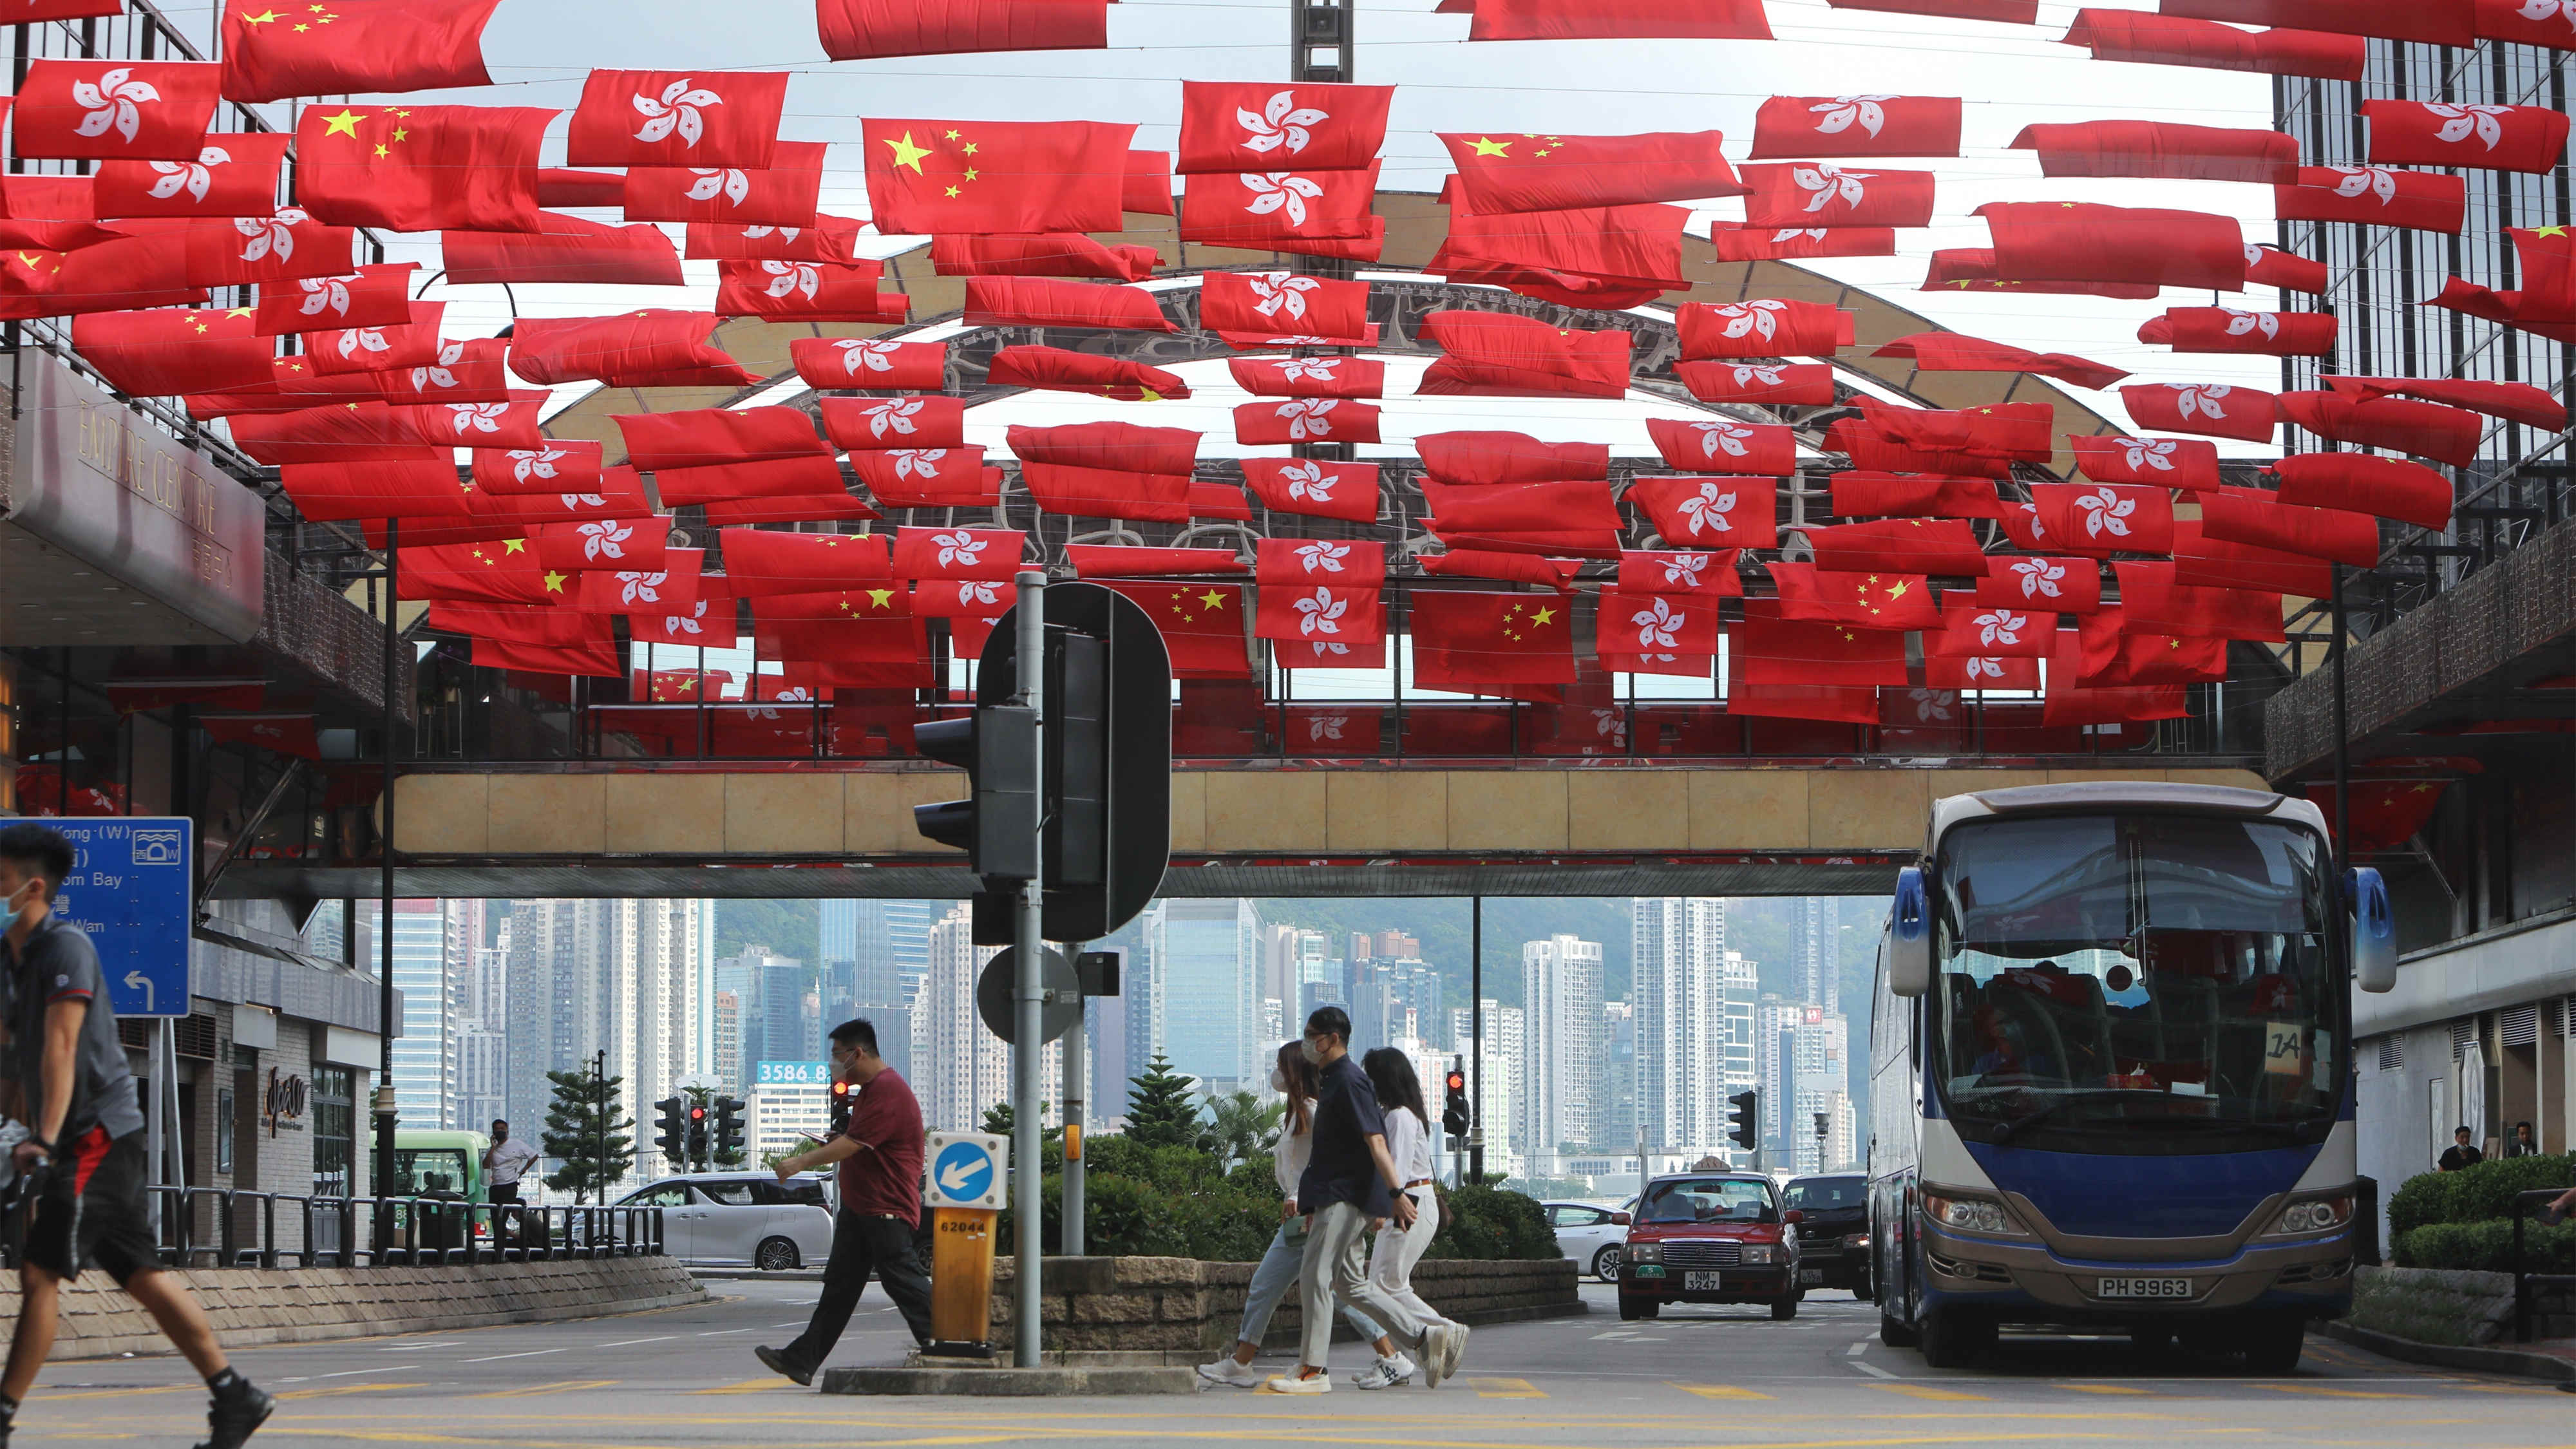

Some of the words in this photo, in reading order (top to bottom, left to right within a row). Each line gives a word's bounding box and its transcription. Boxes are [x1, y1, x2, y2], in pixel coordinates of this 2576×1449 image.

[79, 398, 146, 491] EMPIRE
[154, 450, 216, 535] CENTRE
[99, 825, 130, 840] (W)
[93, 872, 122, 889] Bay
[761, 1065, 808, 1081] 3586
[941, 1222, 985, 1233] 62044
[1695, 1272, 1710, 1281] NM
[1688, 1280, 1716, 1289] 3247
[2103, 1279, 2128, 1295] PH
[2134, 1280, 2188, 1296] 9963
